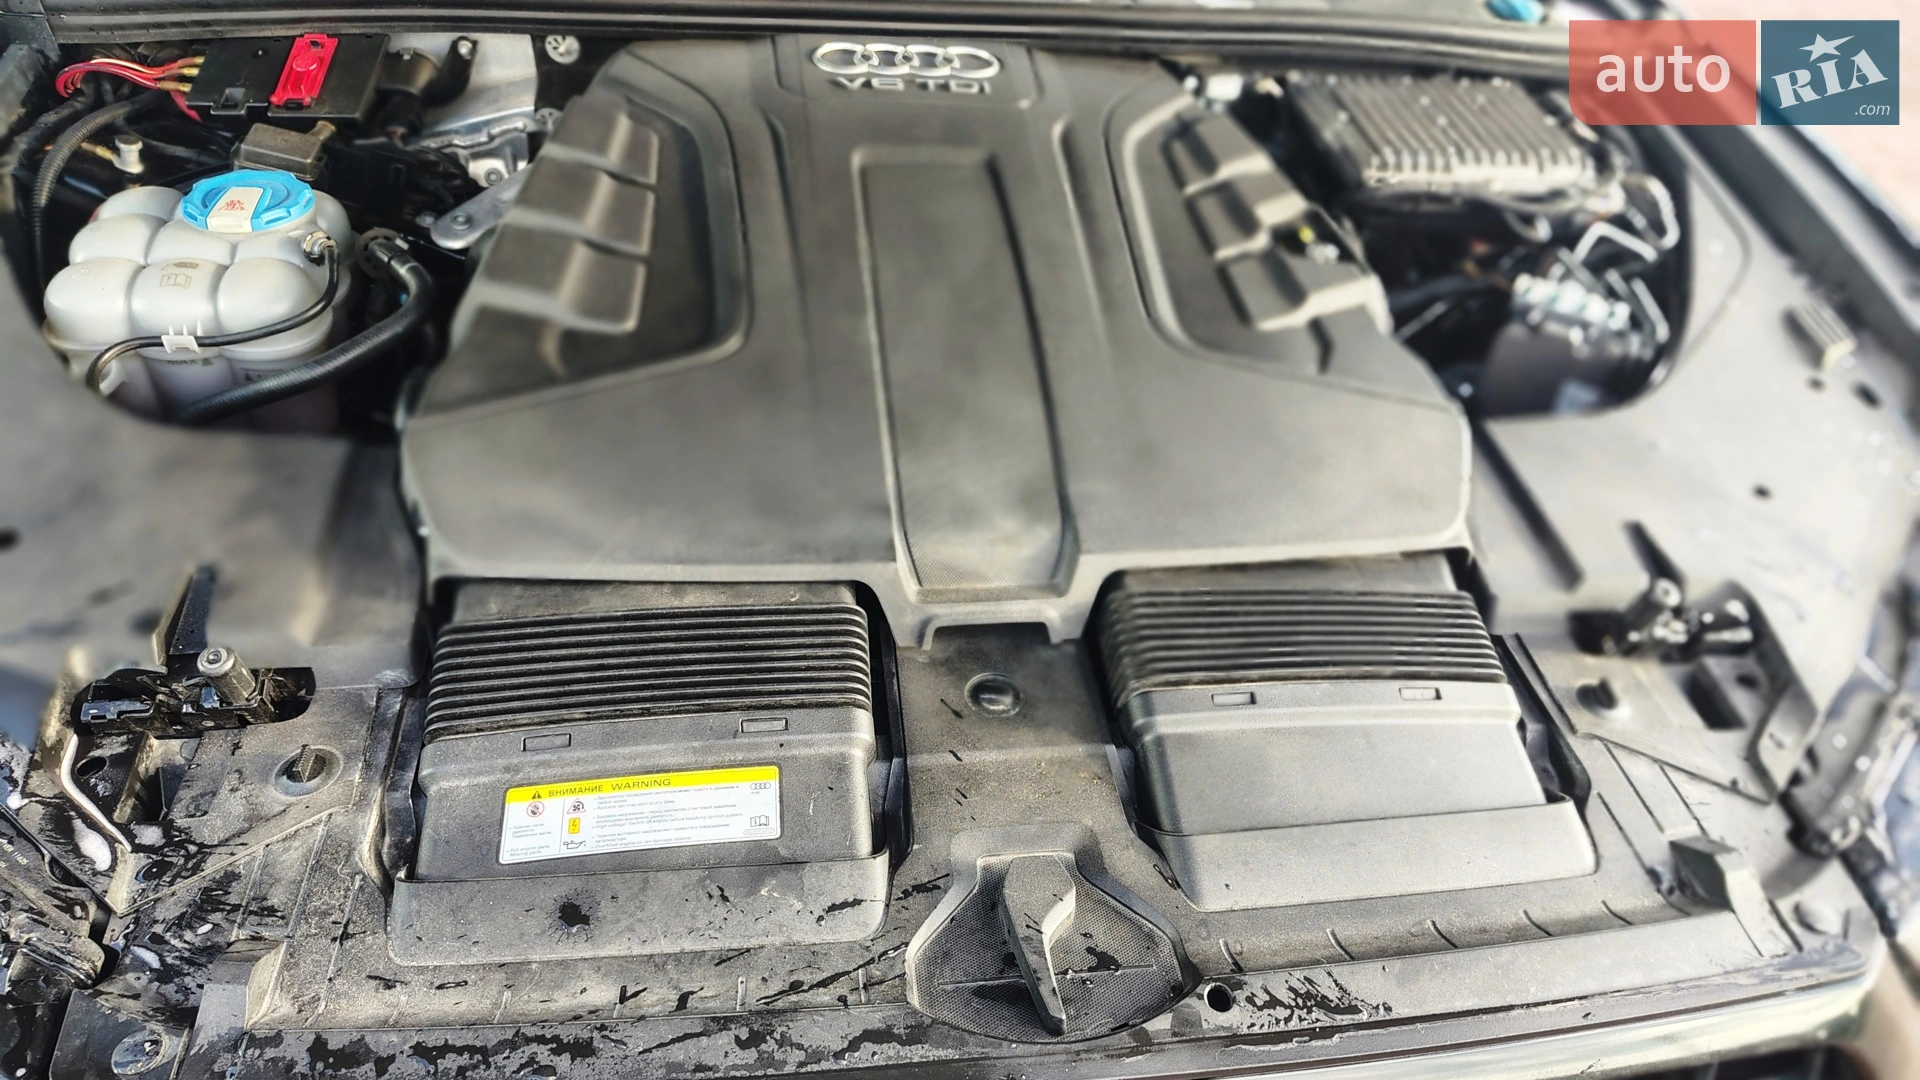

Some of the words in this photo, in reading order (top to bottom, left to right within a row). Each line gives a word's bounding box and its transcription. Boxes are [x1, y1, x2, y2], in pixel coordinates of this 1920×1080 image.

[834, 76, 905, 91] V6
[915, 78, 992, 94] TDI
[548, 784, 604, 797] ВНИМАНИЕ
[611, 778, 671, 791] WARNING
